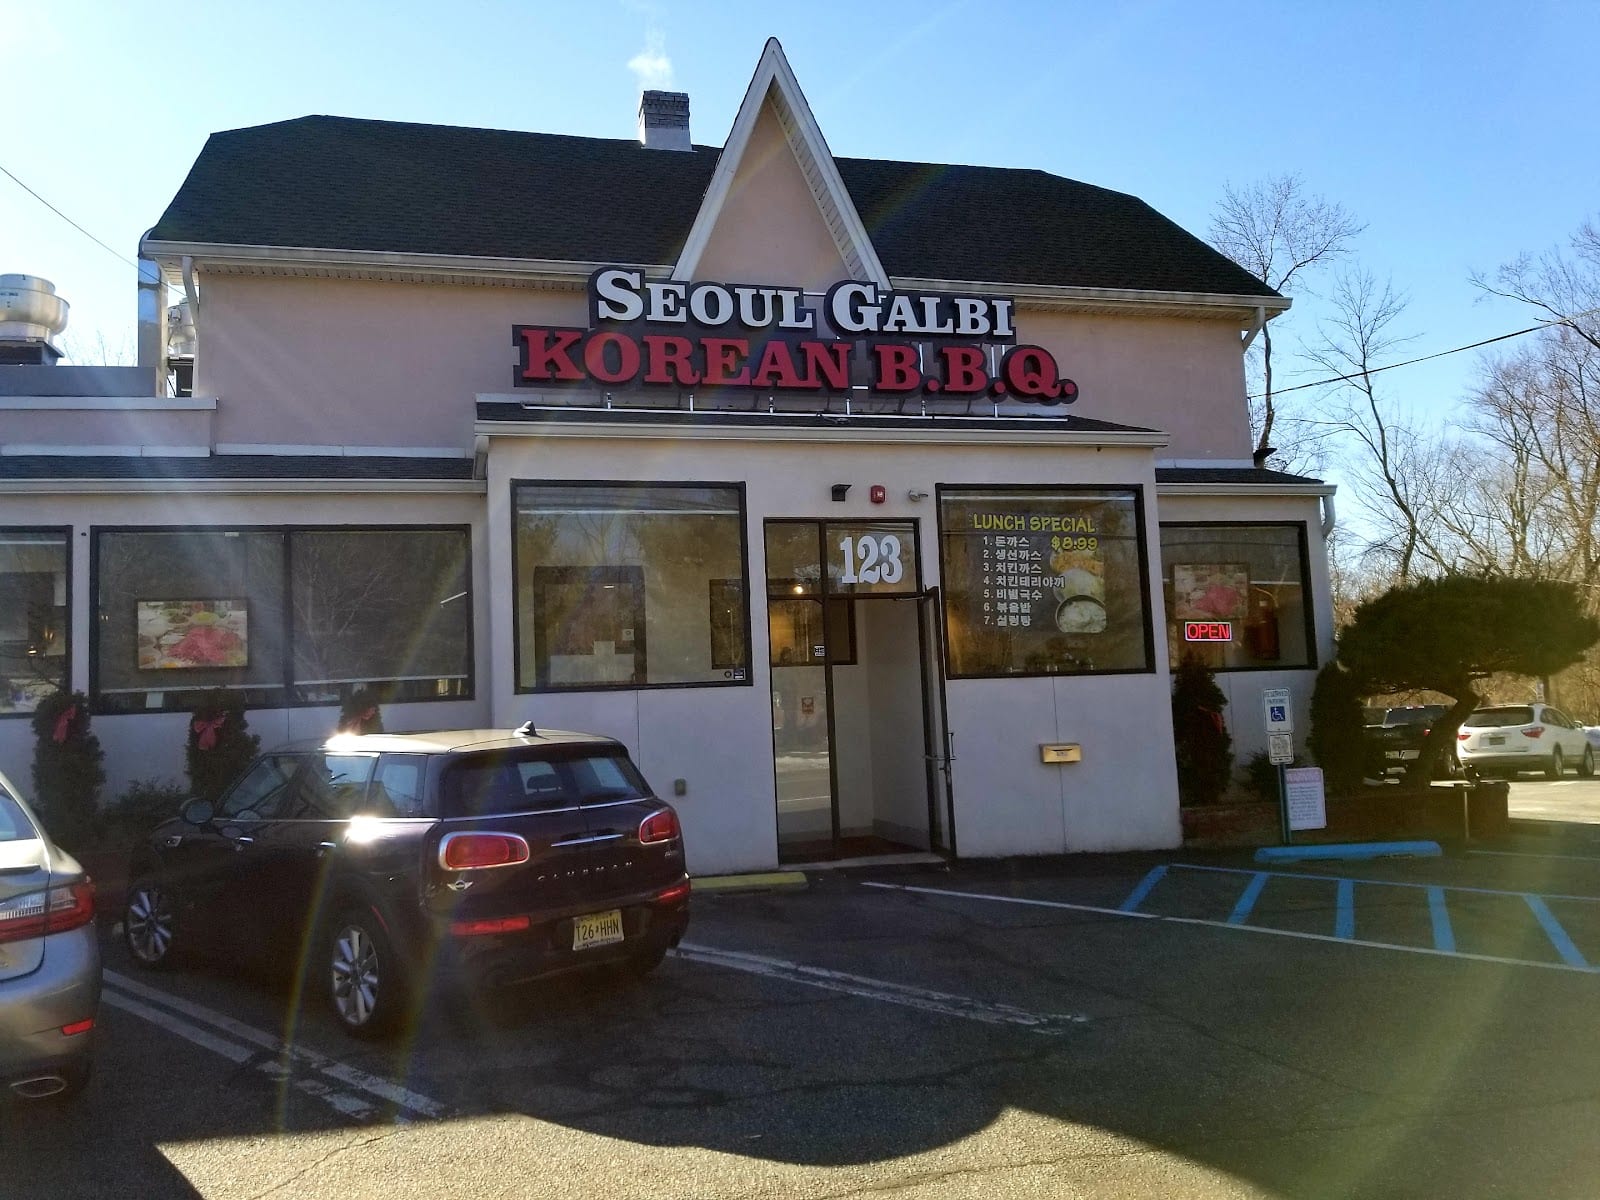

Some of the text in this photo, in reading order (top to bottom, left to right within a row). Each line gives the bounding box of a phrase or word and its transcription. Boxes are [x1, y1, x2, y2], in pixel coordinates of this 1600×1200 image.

[596, 270, 1013, 336] SEOUL GALBI
[521, 329, 1077, 398] KOREAN B.B.Q.
[973, 513, 1096, 533] LUNCH SPECIAL
[839, 535, 903, 584] 123
[1051, 535, 1098, 551] $8.99
[1187, 624, 1230, 638] OPEN
